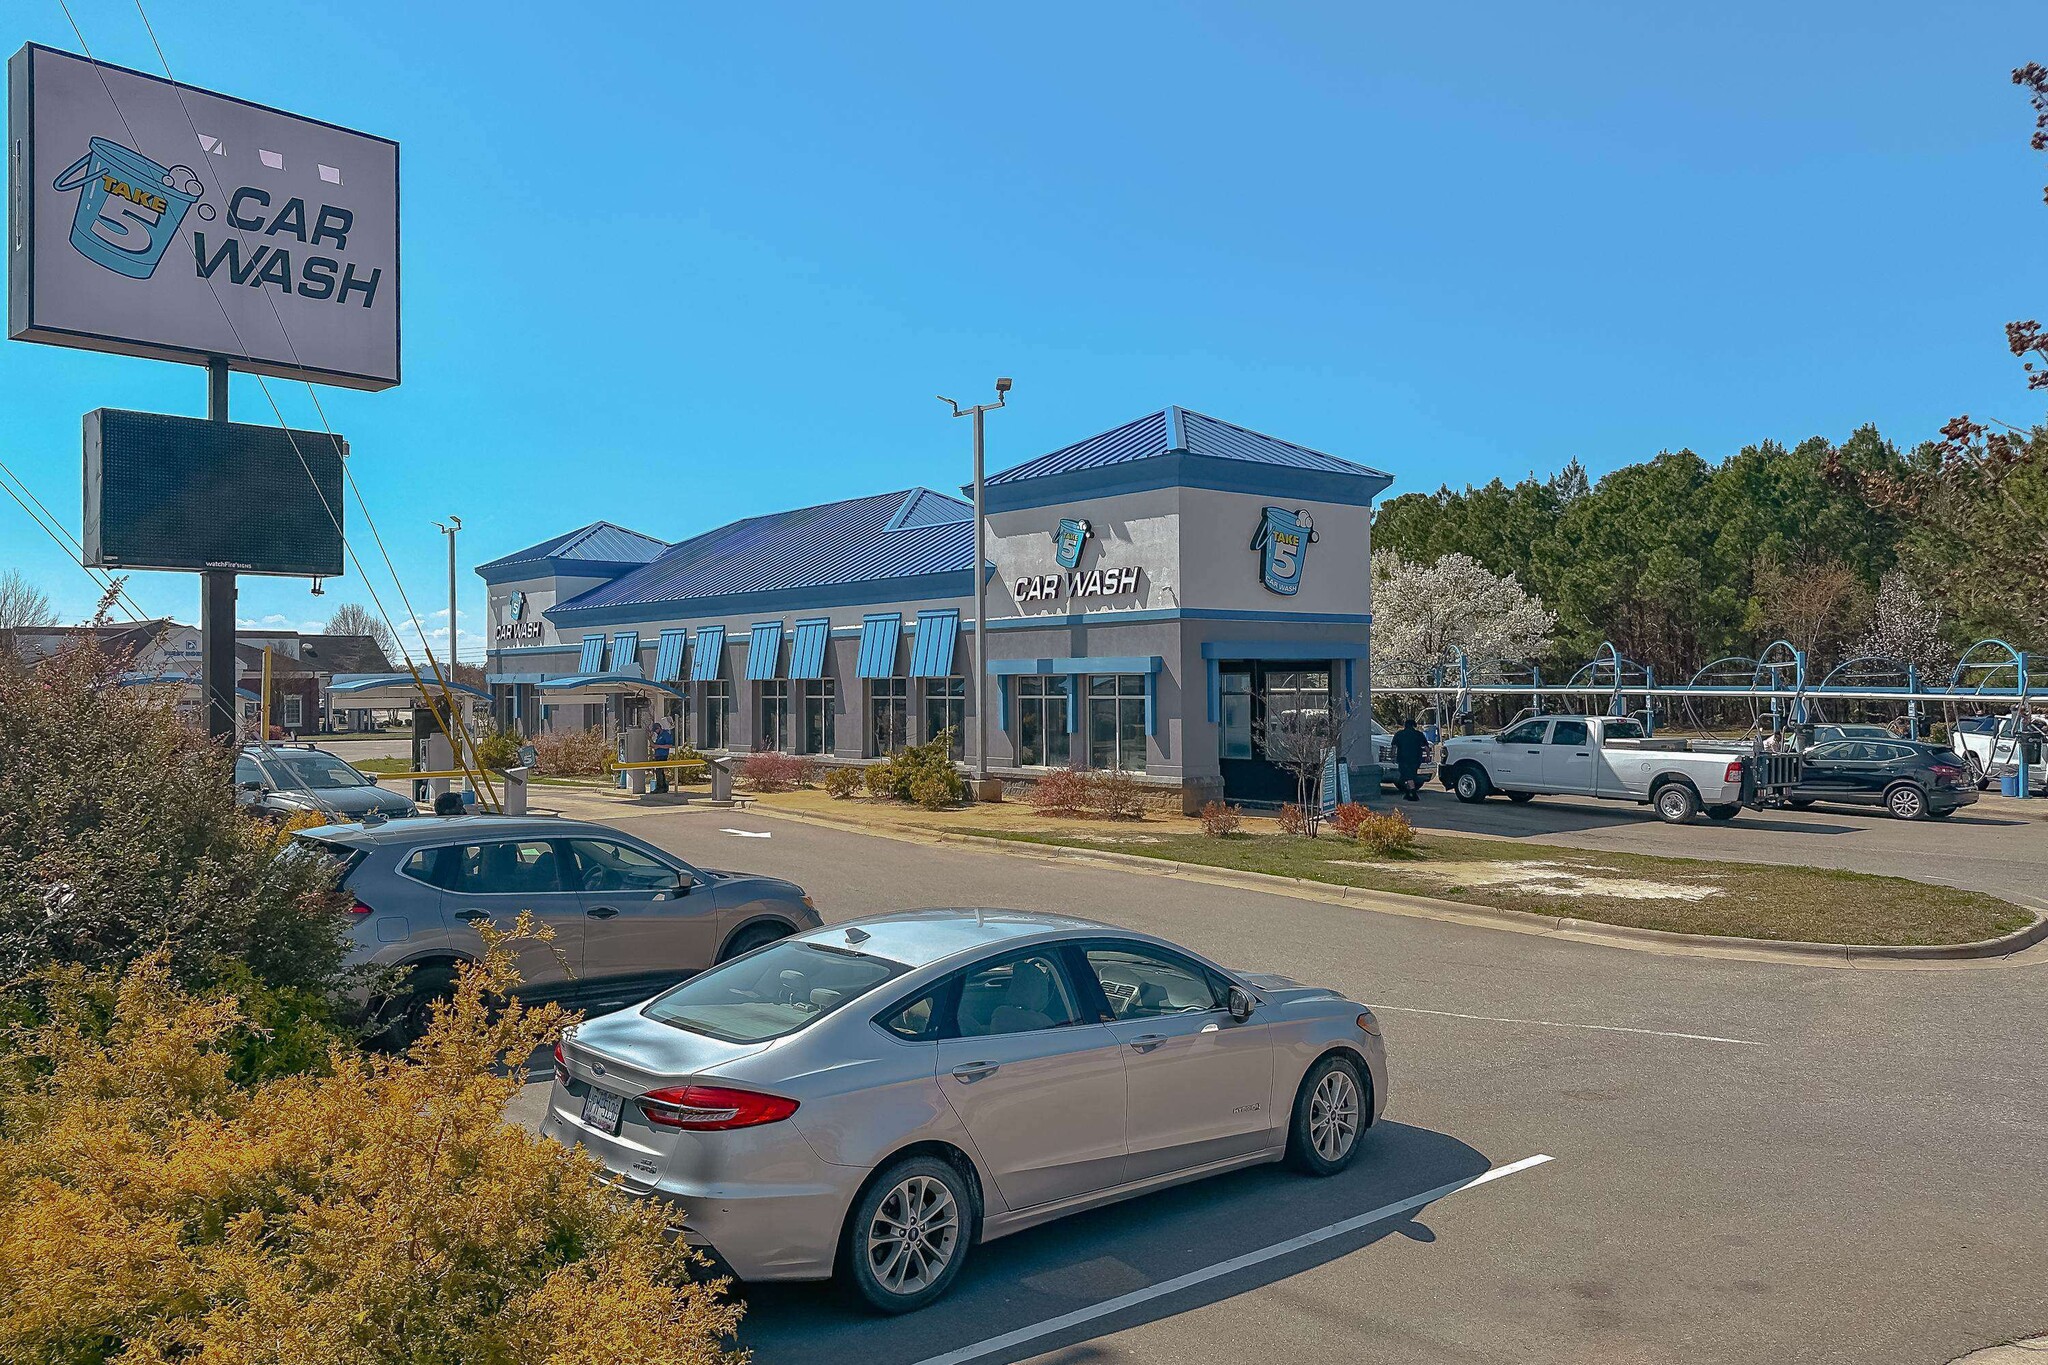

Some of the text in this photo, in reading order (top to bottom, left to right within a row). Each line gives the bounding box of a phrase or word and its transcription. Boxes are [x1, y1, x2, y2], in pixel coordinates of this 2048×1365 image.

[102, 174, 168, 215] TAKE
[90, 193, 159, 254] 5
[226, 186, 354, 251] CAR
[193, 231, 382, 309] WASH
[1061, 539, 1077, 559] 5
[1063, 532, 1079, 541] TAKE
[1273, 531, 1299, 547] TAKE
[1271, 543, 1298, 579] 5
[1014, 566, 1141, 602] CAR WASH
[1265, 575, 1298, 592] CAR WASH
[496, 622, 541, 640] CAR WASH
